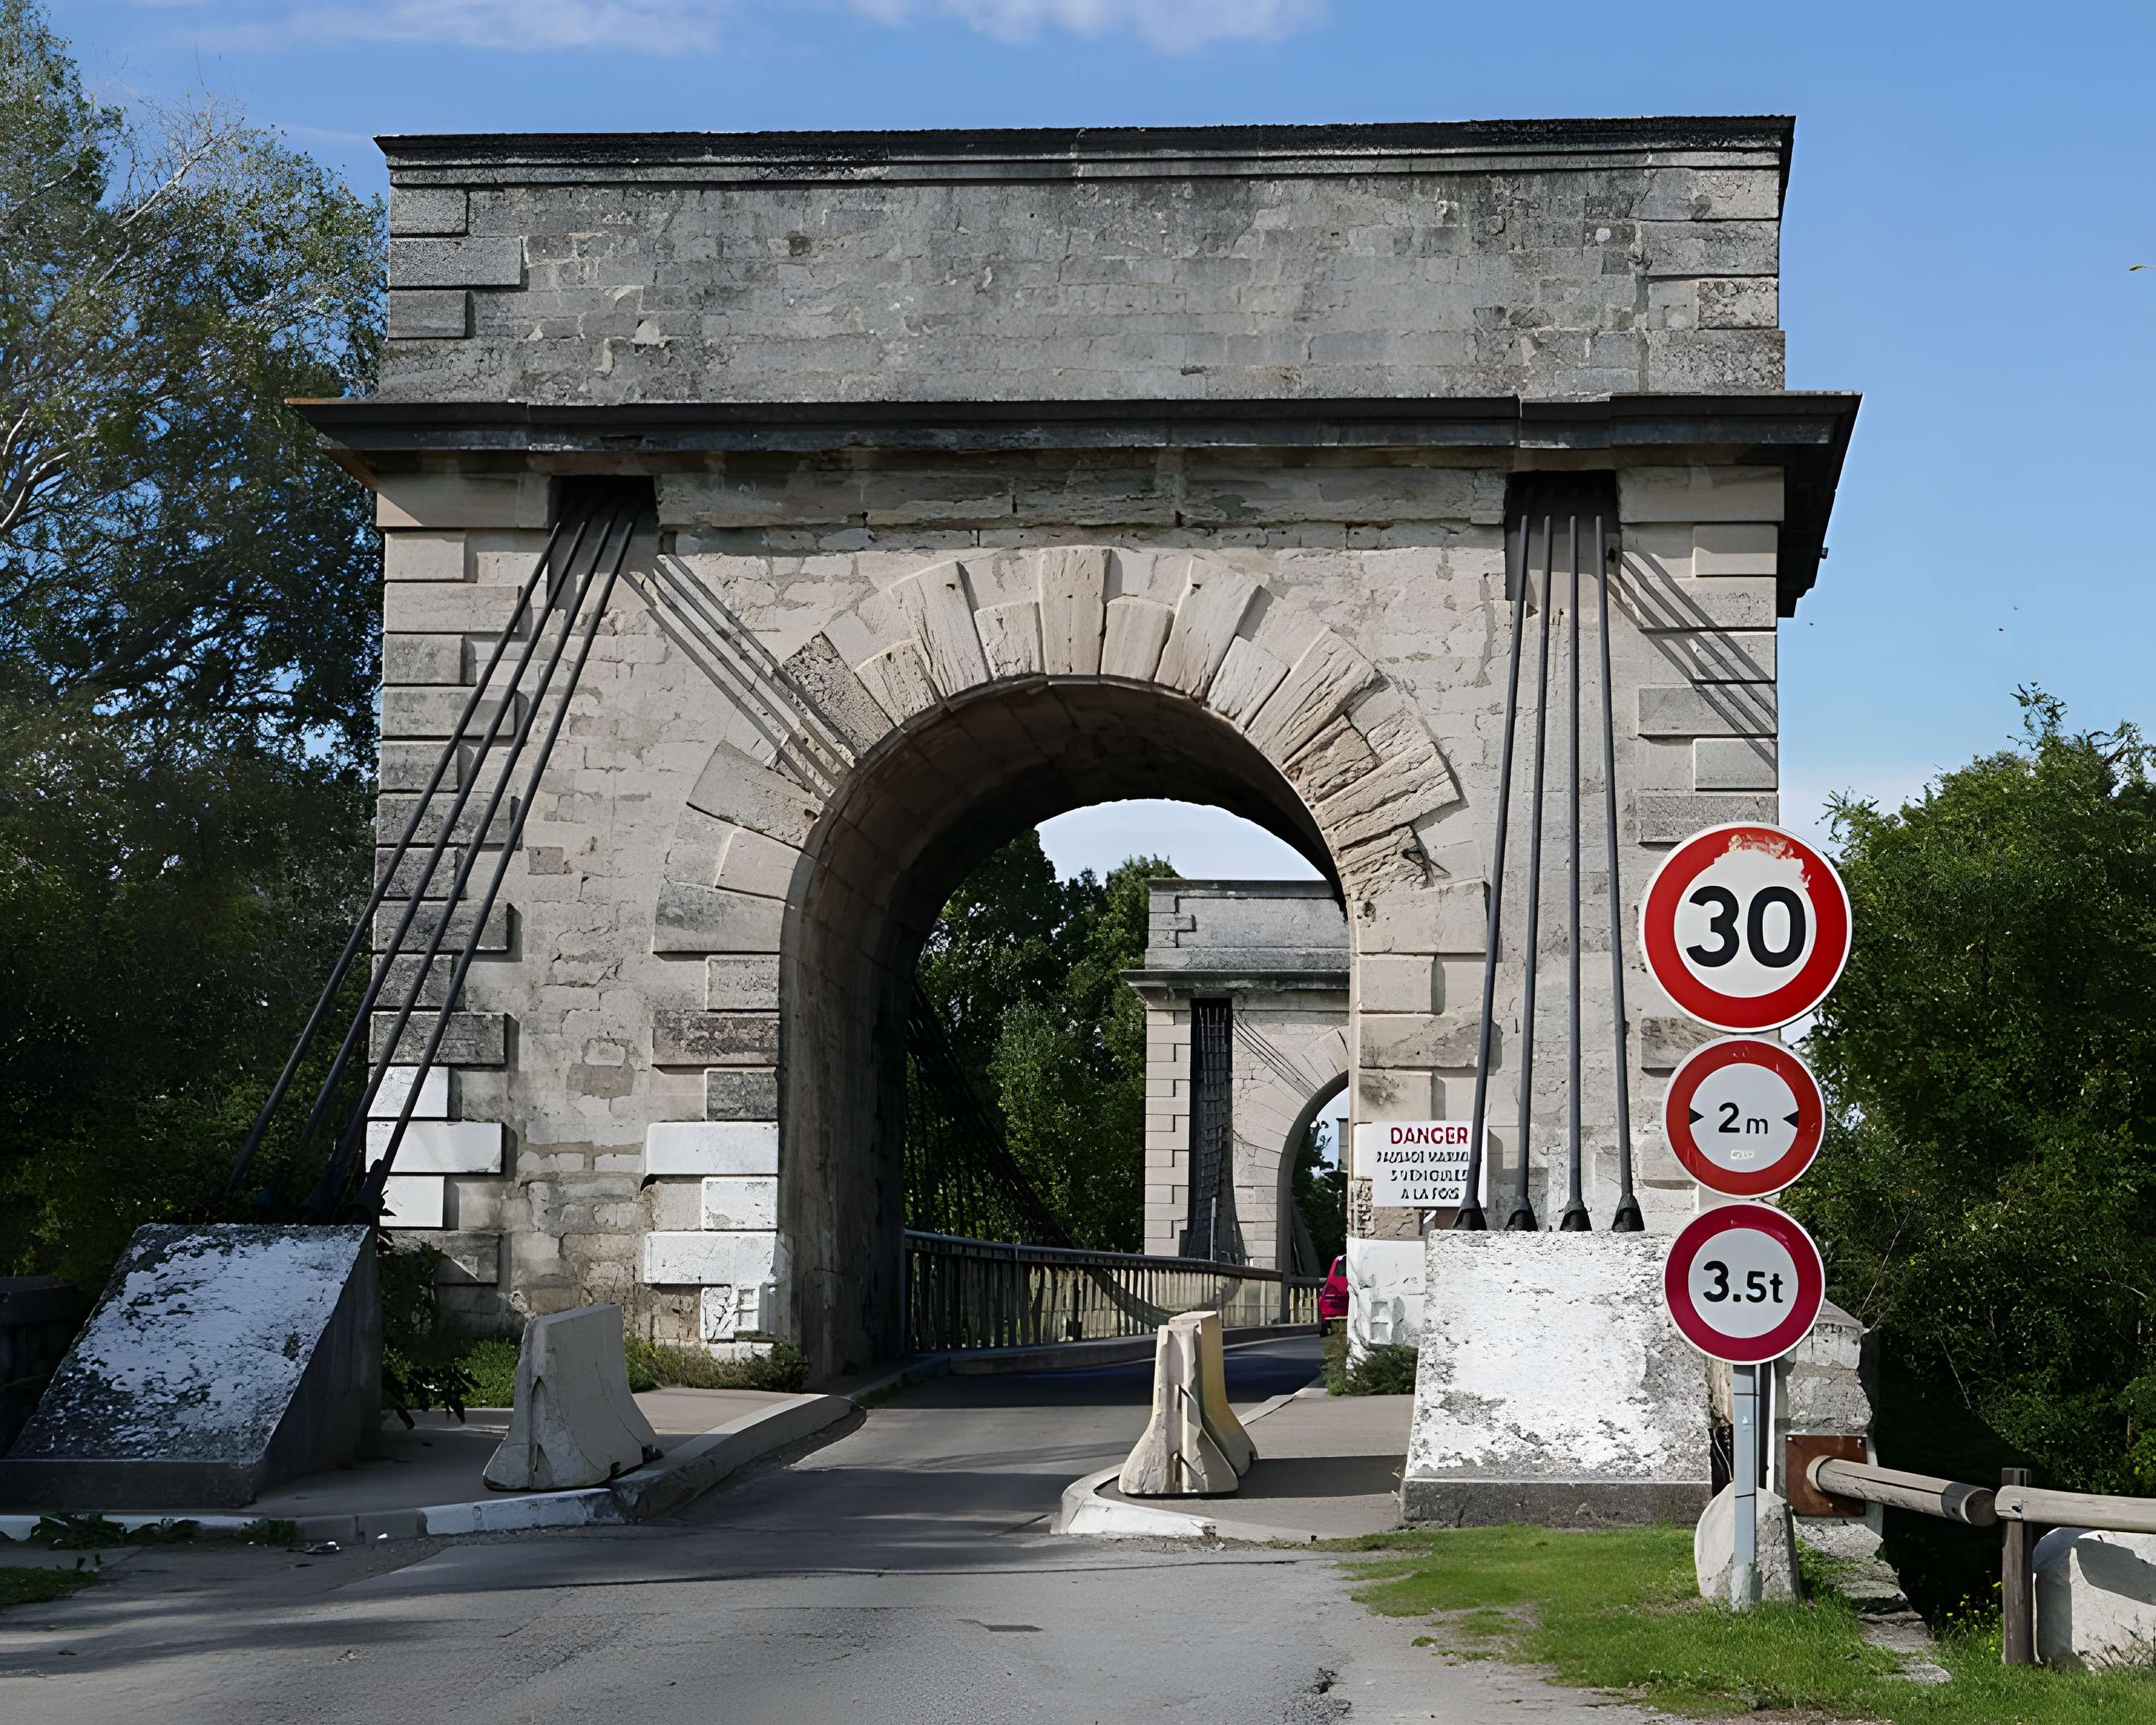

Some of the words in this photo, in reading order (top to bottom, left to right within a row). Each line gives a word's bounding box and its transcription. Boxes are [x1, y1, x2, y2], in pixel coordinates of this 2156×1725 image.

[1686, 886, 1806, 967] 30
[1391, 1127, 1468, 1144] DANGER
[1703, 1260, 1783, 1303] 3.5t
